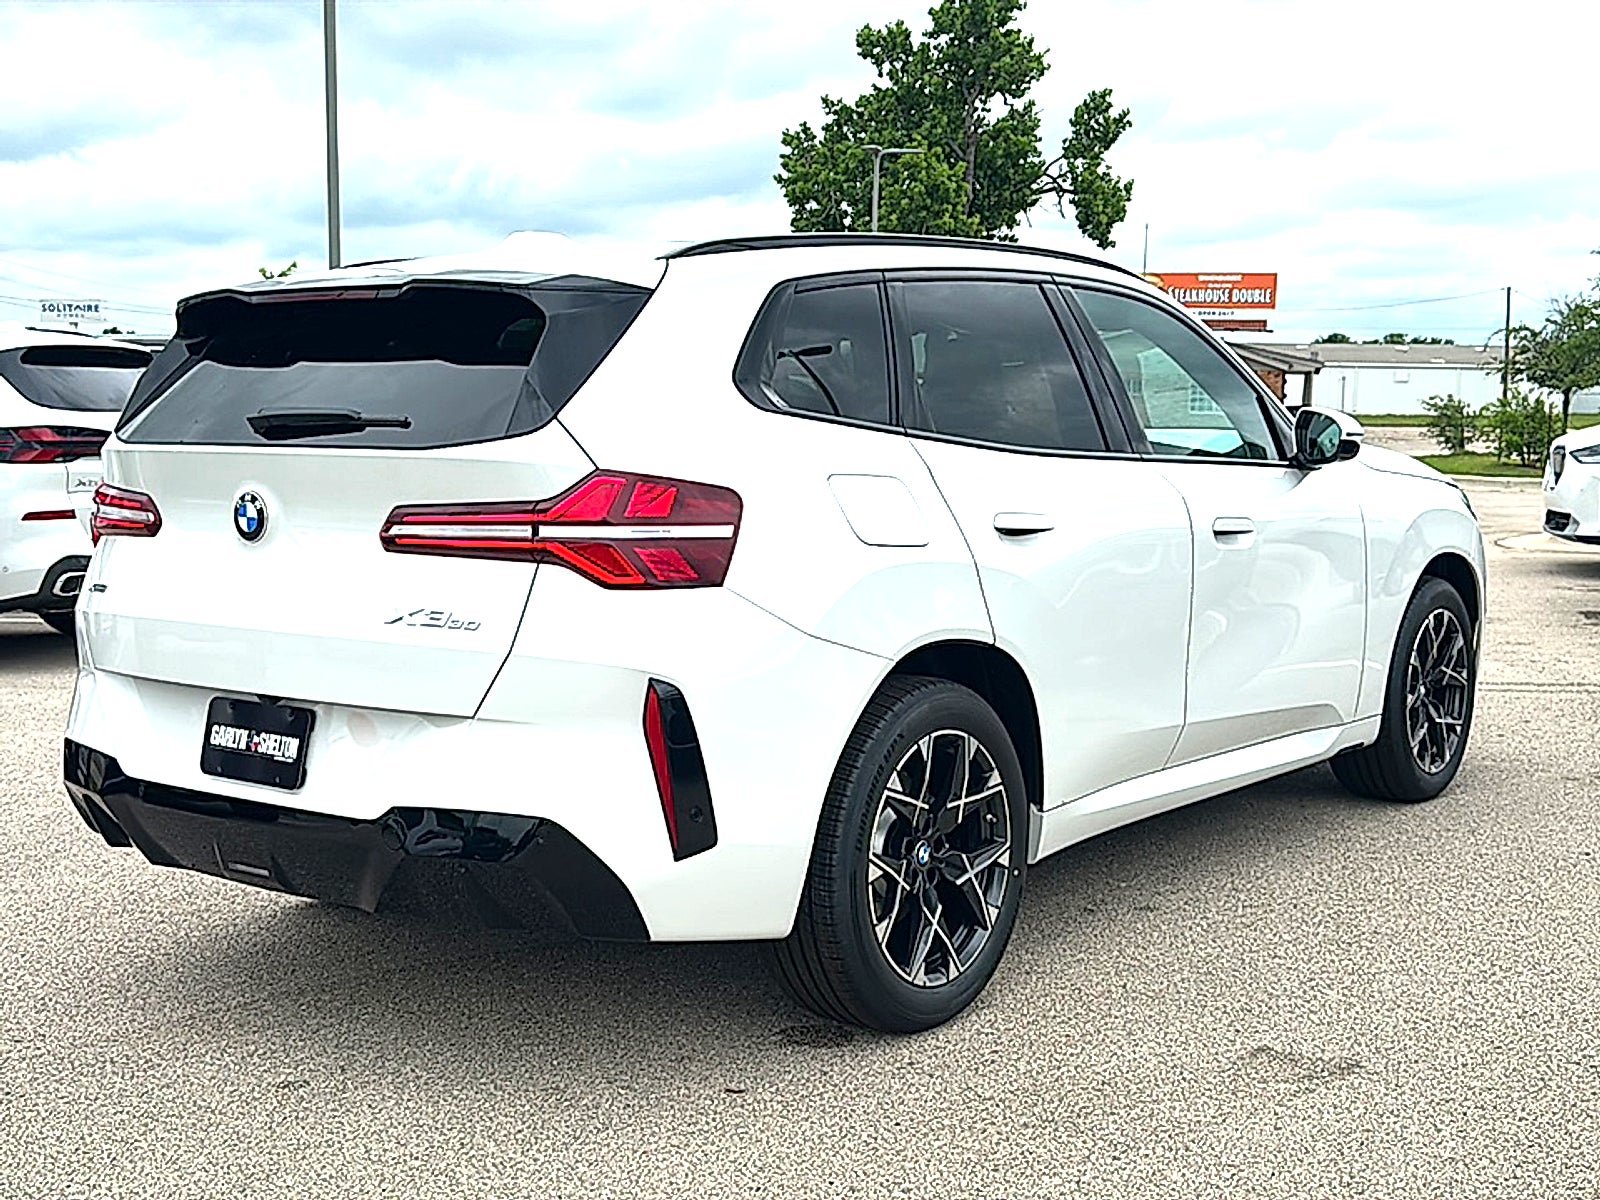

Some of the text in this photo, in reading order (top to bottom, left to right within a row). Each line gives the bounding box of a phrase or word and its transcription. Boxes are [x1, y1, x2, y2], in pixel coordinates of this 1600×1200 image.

[1168, 286, 1272, 303] STEAKHOUSE DOUBLE
[41, 303, 100, 313] SOLITAIRE
[257, 731, 301, 760] SHELTON
